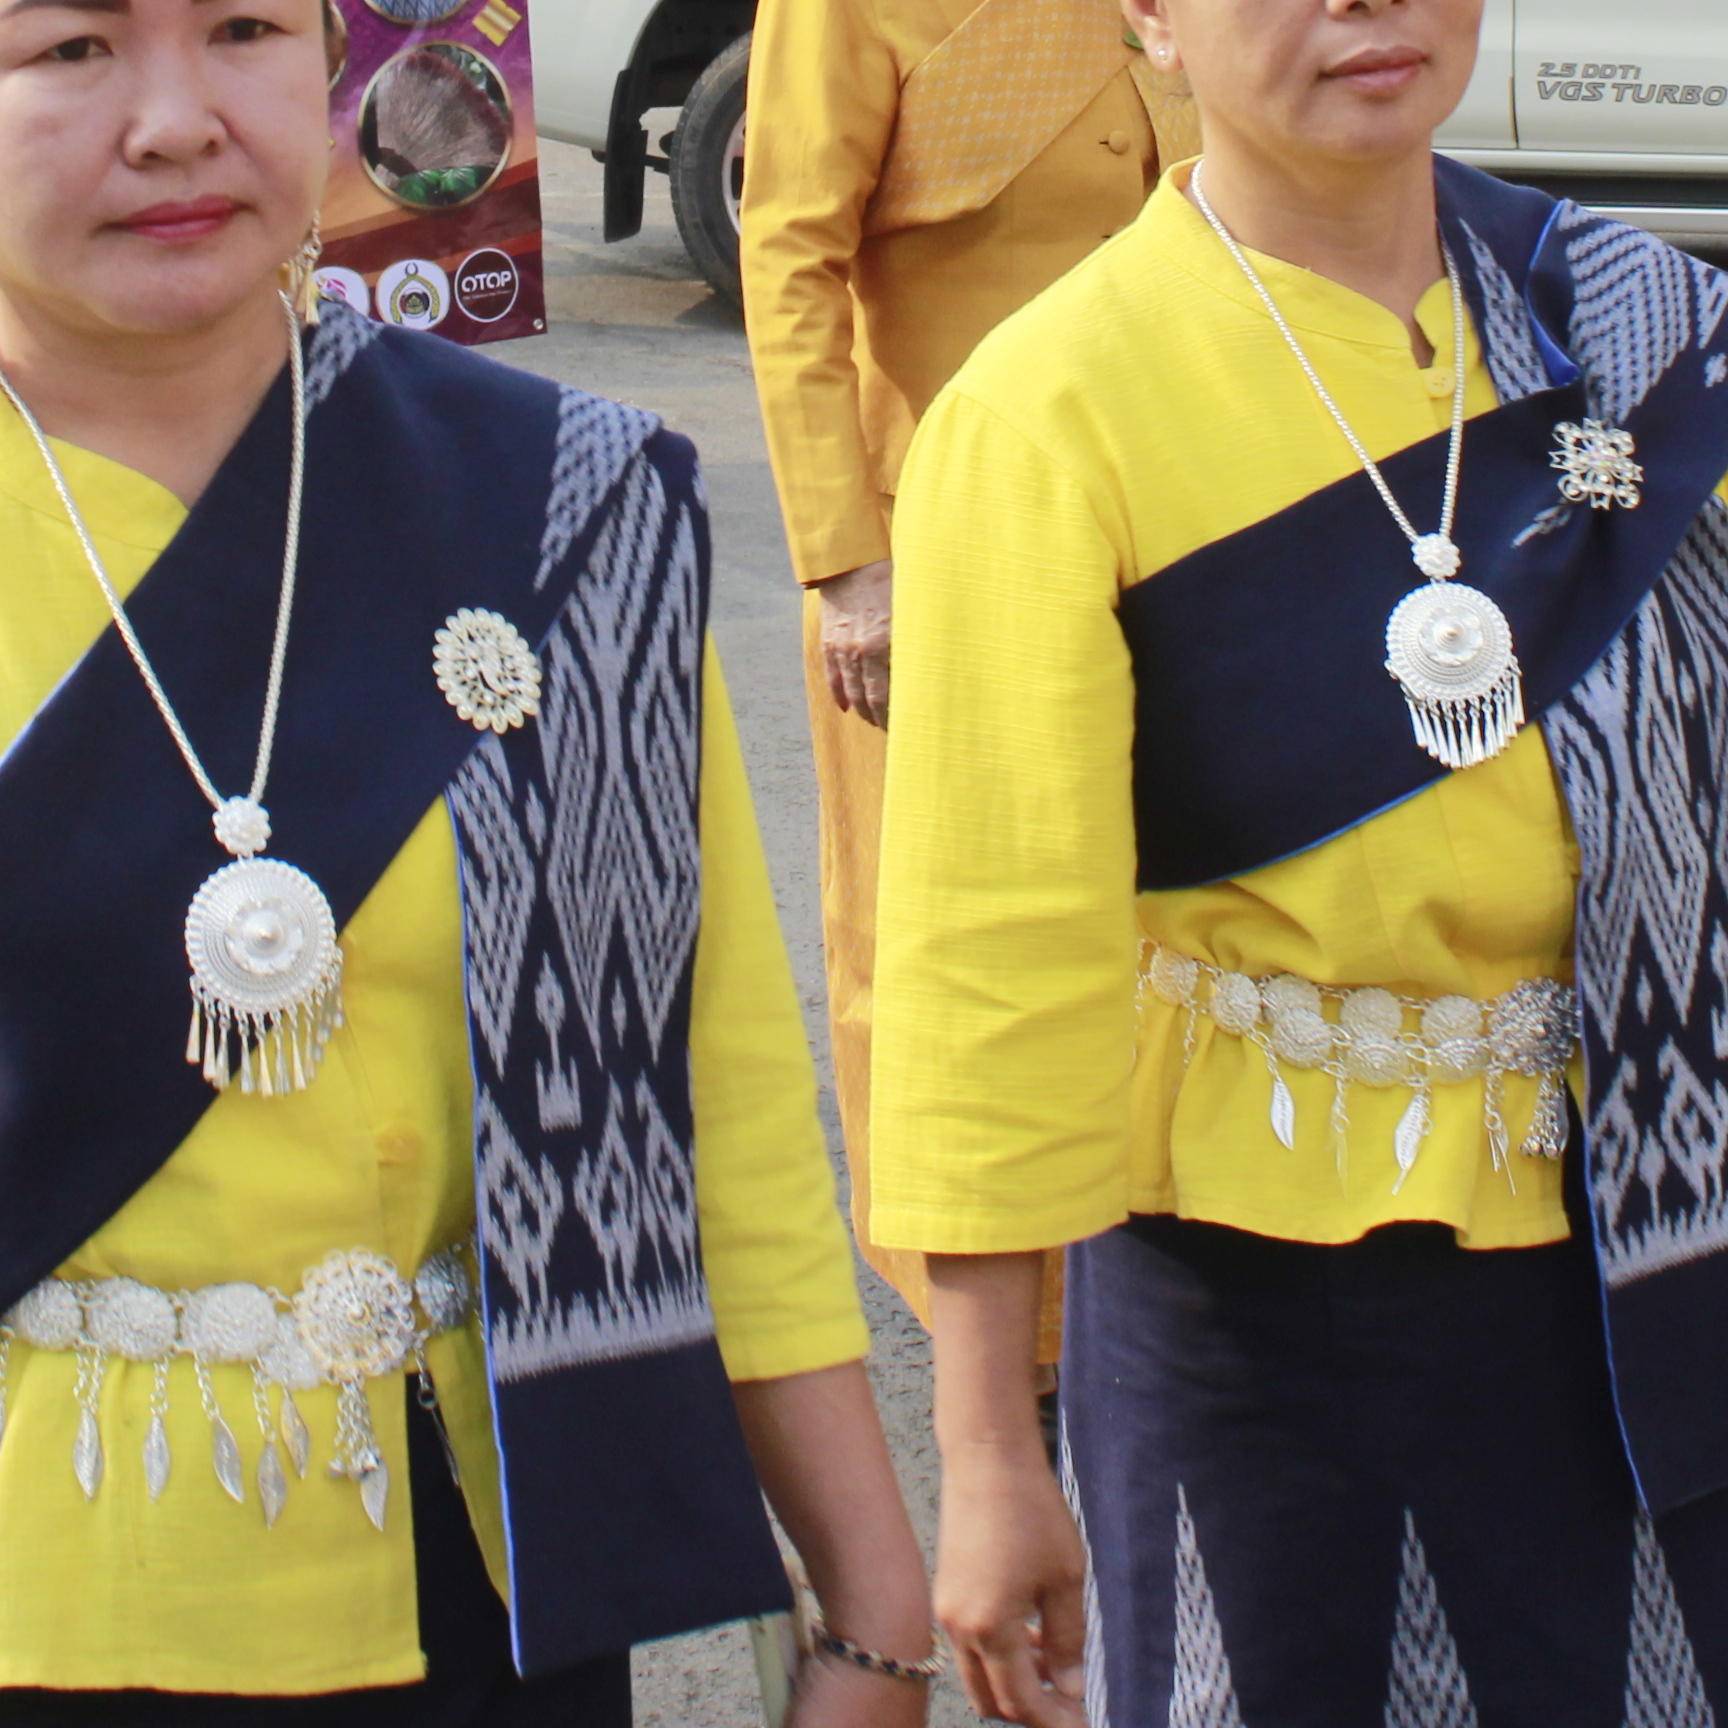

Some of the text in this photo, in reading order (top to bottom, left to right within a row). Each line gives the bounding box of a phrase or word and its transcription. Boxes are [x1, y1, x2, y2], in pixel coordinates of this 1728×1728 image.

[1537, 62, 1577, 79] 2.5
[1537, 81, 1728, 107] VGS TURBO
[461, 270, 512, 293] OTOP
